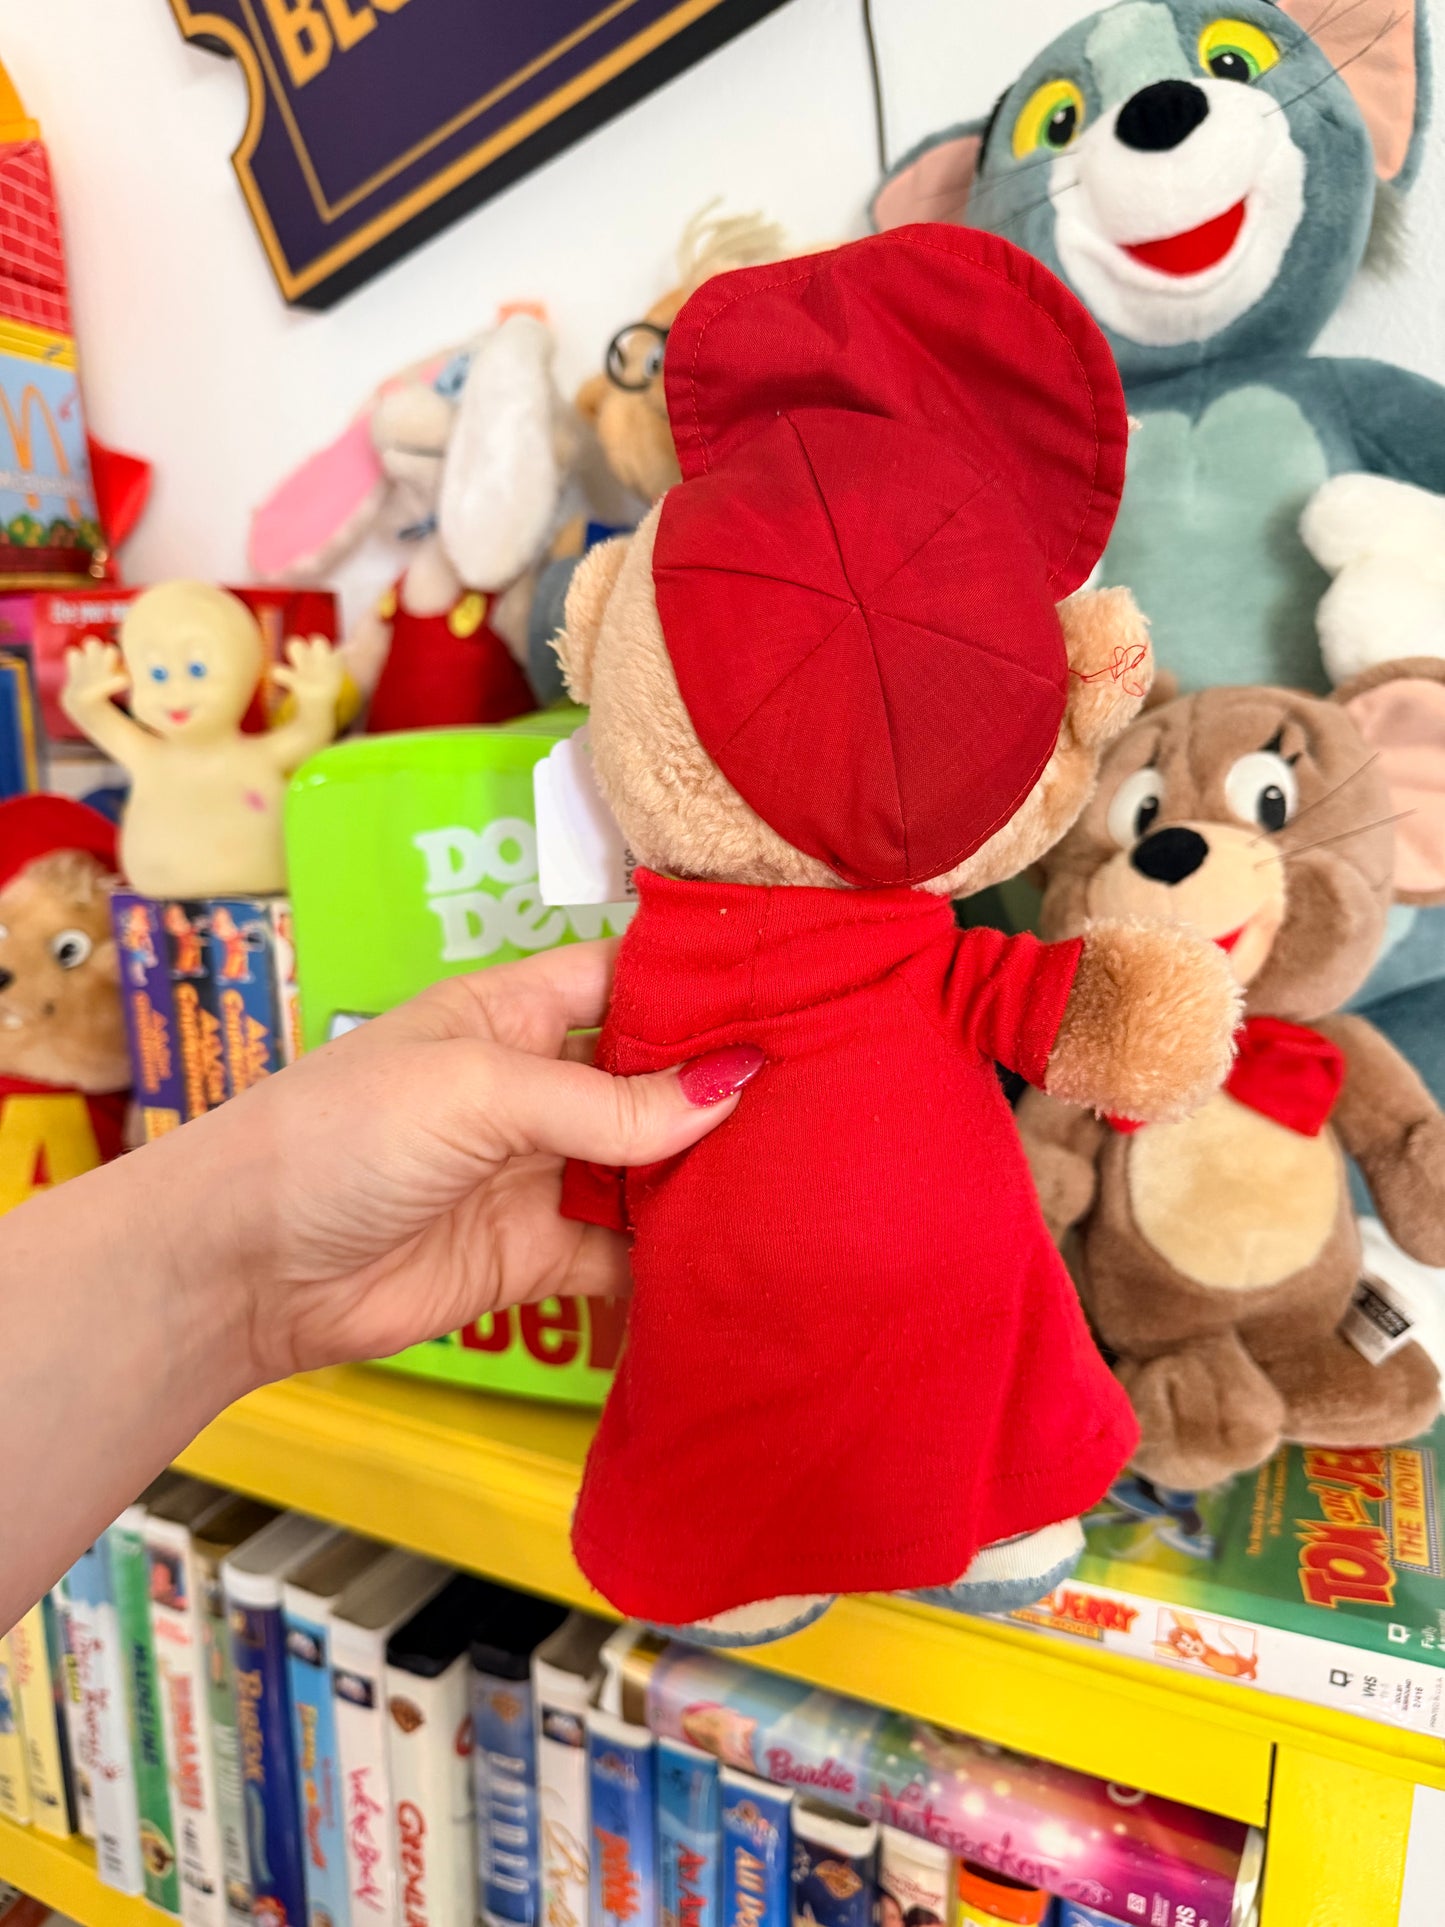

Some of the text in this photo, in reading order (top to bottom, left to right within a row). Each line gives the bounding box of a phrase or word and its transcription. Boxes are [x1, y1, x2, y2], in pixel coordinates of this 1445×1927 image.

[1394, 1454, 1422, 1557] THE MOVIE
[1293, 1518, 1397, 1608] TOM
[1051, 1589, 1139, 1633] JERRY
[1362, 1675, 1377, 1697] VHS
[766, 1748, 856, 1793] Barbie
[1174, 1904, 1197, 1927] HS
